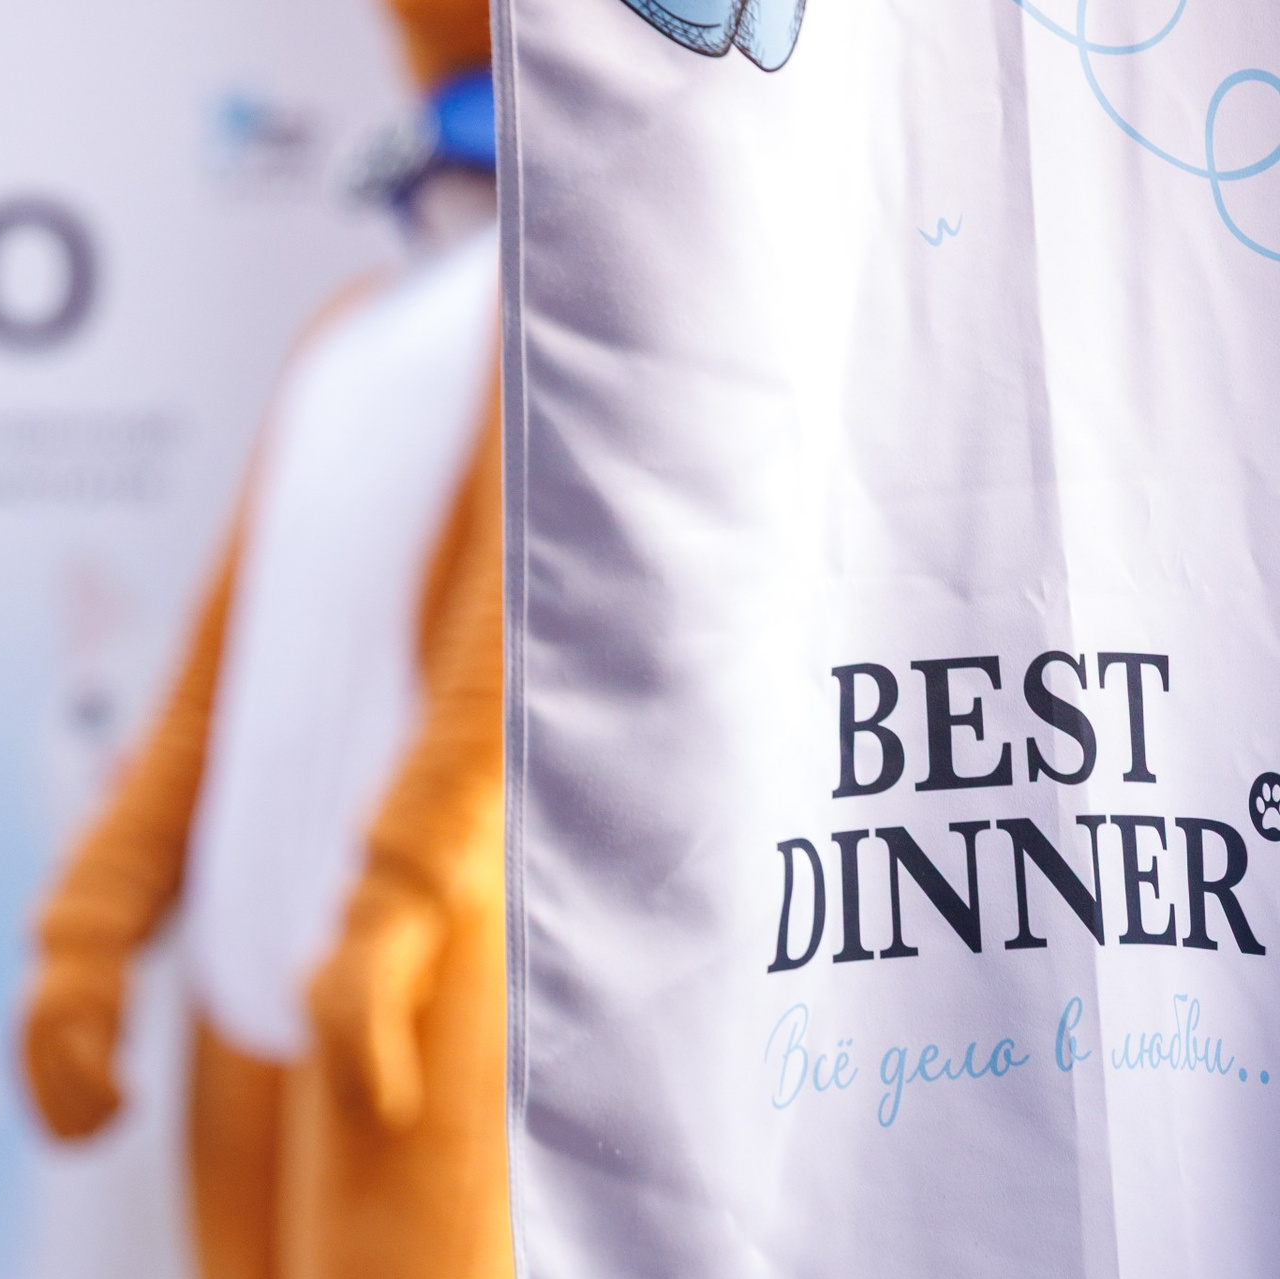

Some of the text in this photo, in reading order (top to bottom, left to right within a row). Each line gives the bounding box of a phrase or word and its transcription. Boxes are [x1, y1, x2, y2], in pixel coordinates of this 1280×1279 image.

[831, 650, 1170, 799] BEST
[767, 814, 1266, 974] DINNER
[764, 1003, 859, 1109] Всё
[878, 1036, 1030, 1128] дело
[1055, 996, 1092, 1073] в
